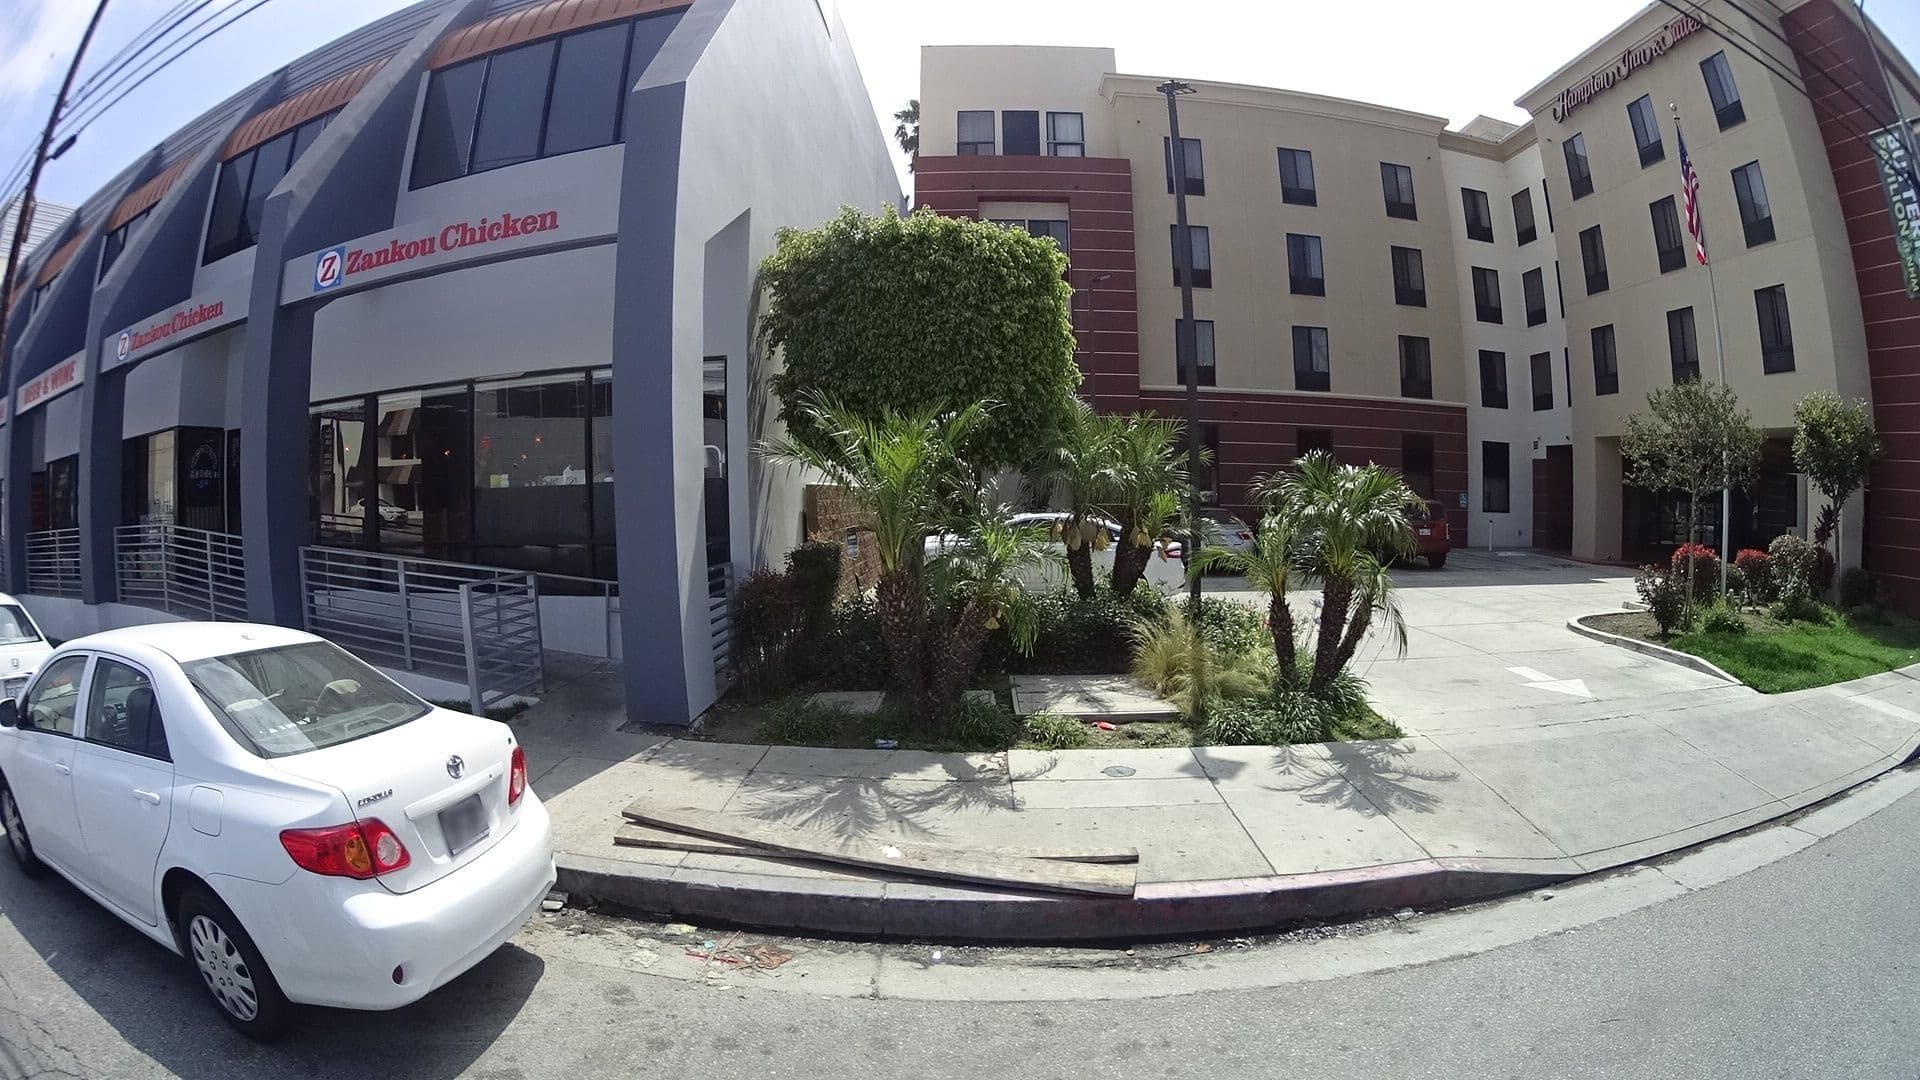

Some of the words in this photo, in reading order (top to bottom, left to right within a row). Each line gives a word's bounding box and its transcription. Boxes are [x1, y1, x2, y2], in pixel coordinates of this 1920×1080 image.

[1553, 70, 1617, 123] Hampton
[1617, 49, 1653, 80] Inn
[346, 236, 436, 276] Zankou
[440, 210, 559, 251] Chicken
[1876, 137, 1910, 237] PAVILION
[1906, 255, 1920, 292] NHM
[320, 255, 337, 283] Z
[131, 322, 172, 351] Zankou
[171, 300, 224, 333] Chicken
